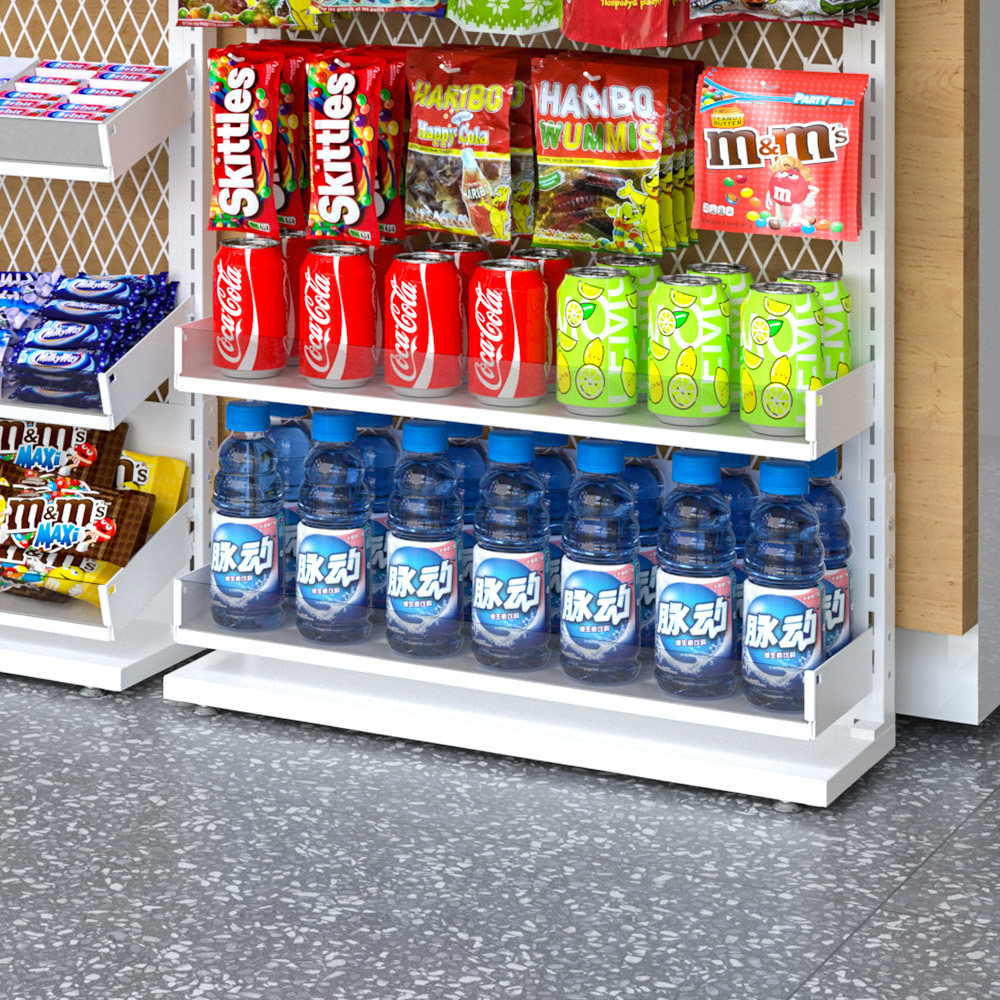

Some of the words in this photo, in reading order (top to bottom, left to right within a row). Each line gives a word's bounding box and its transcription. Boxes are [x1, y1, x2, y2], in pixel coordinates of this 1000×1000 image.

[414, 79, 504, 113] HARIBO
[539, 81, 655, 119] HARIBO
[793, 92, 829, 106] PARTY
[215, 67, 260, 218] Skittles
[314, 72, 361, 226] Skittles
[417, 119, 458, 147] Happy
[458, 123, 490, 146] Cola
[539, 119, 660, 153] WUMMIS
[705, 122, 849, 168] m&m's
[773, 186, 791, 202] m
[216, 256, 243, 364] Coca-Cola
[304, 264, 331, 373] Coca-Cola
[390, 273, 418, 382] Coca-Cola
[475, 281, 503, 391] Coca-Cola
[6, 498, 108, 533] m&m's
[211, 535, 275, 576] 脉动
[296, 547, 361, 588] 脉动
[386, 559, 454, 601] 脉动
[472, 571, 541, 613] 脉动
[562, 583, 631, 625] 脉动
[656, 595, 728, 641] 脉动
[745, 608, 818, 653] 脉动
